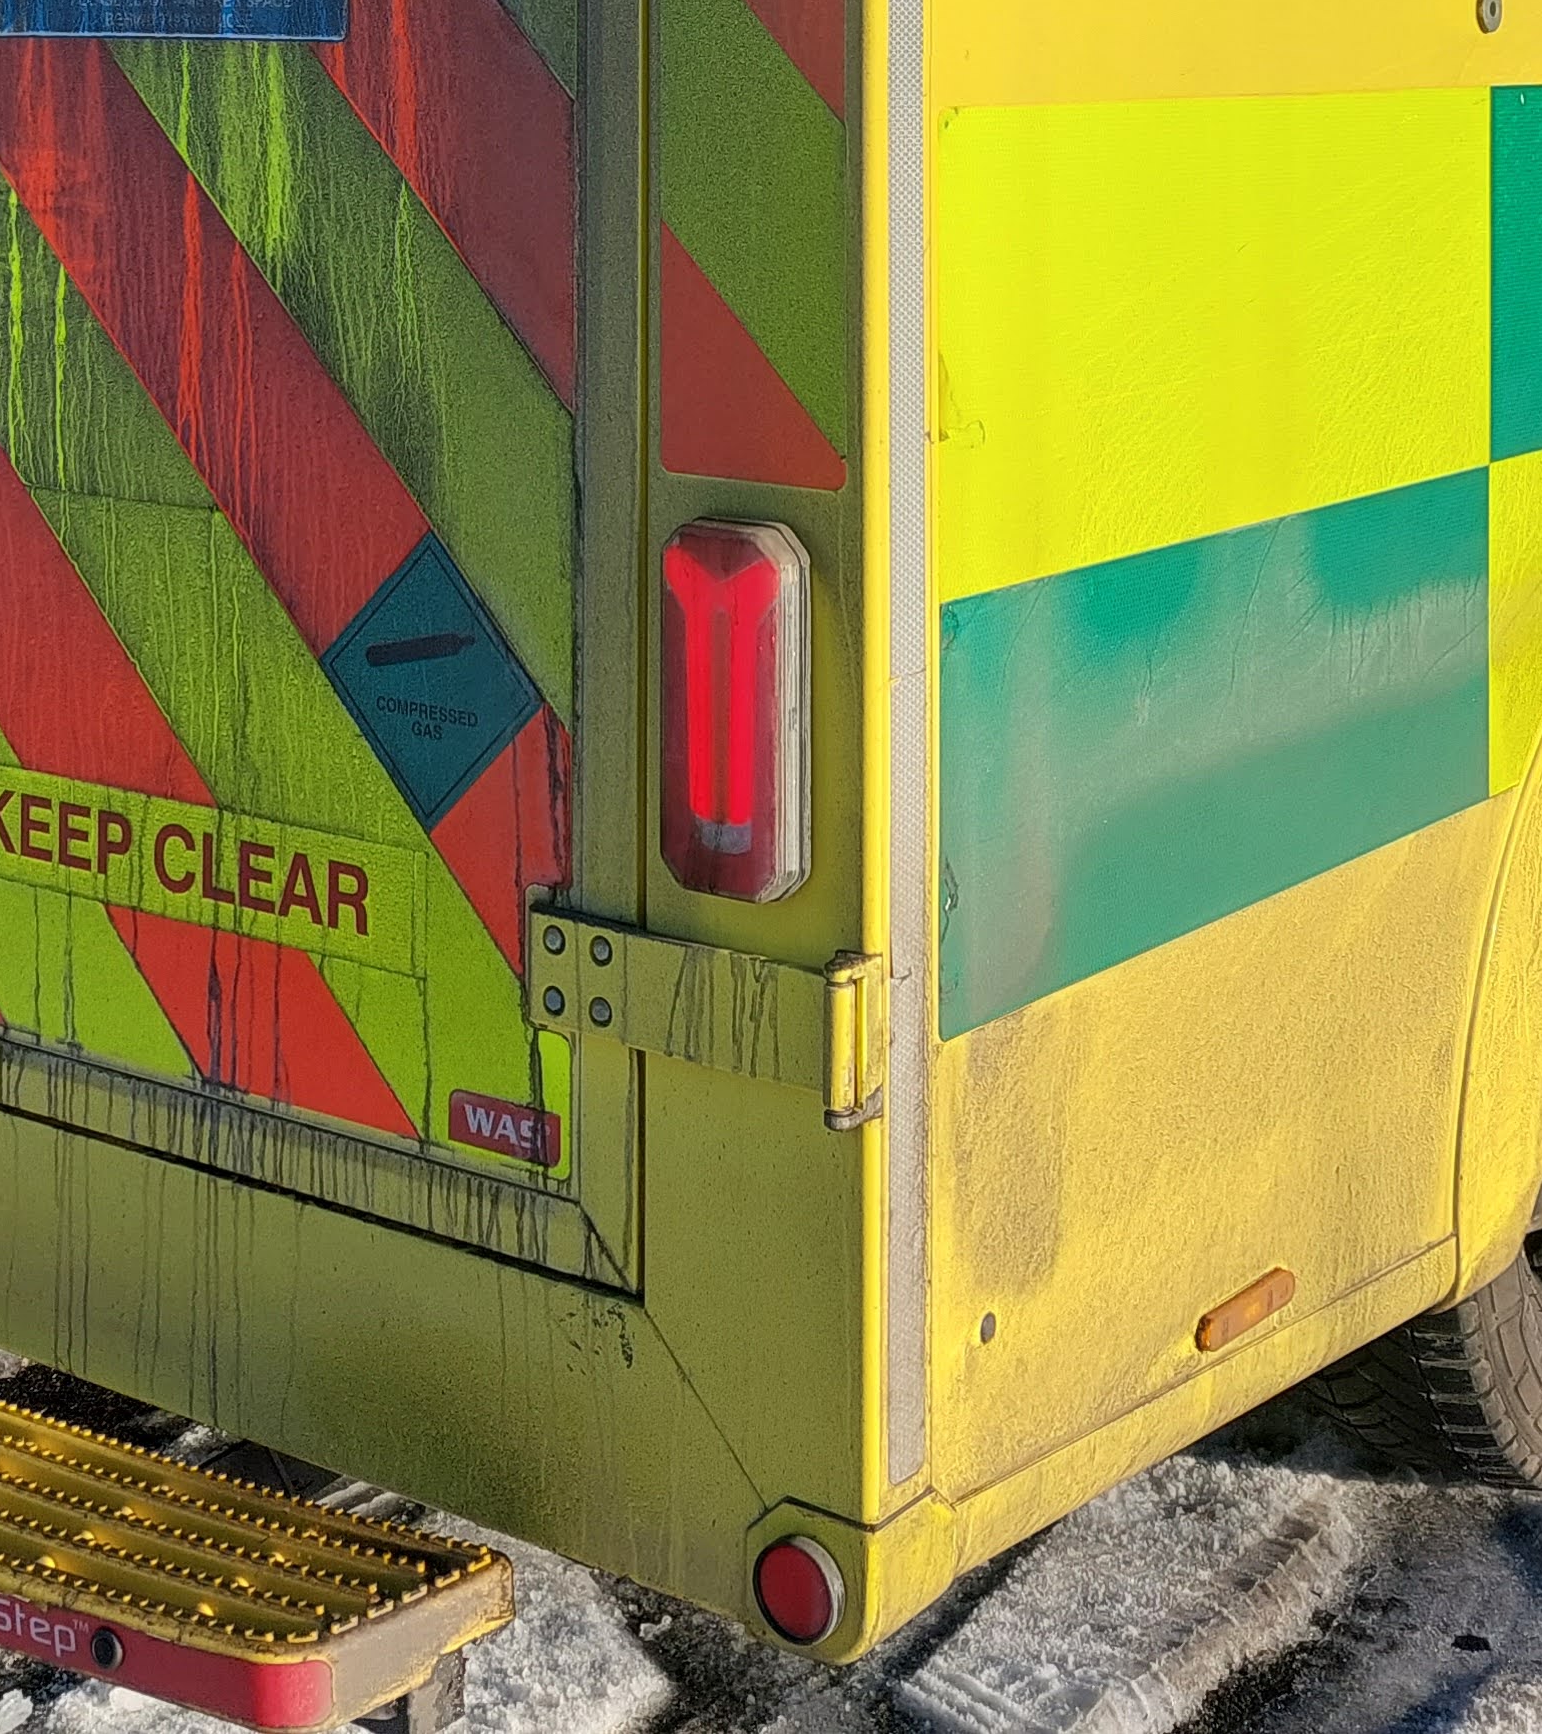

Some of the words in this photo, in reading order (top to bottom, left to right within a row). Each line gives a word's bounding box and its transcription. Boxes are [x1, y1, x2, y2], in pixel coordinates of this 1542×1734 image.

[375, 694, 479, 729] COMPRESSED
[410, 720, 444, 741] GAS
[153, 822, 371, 937] CLEAR
